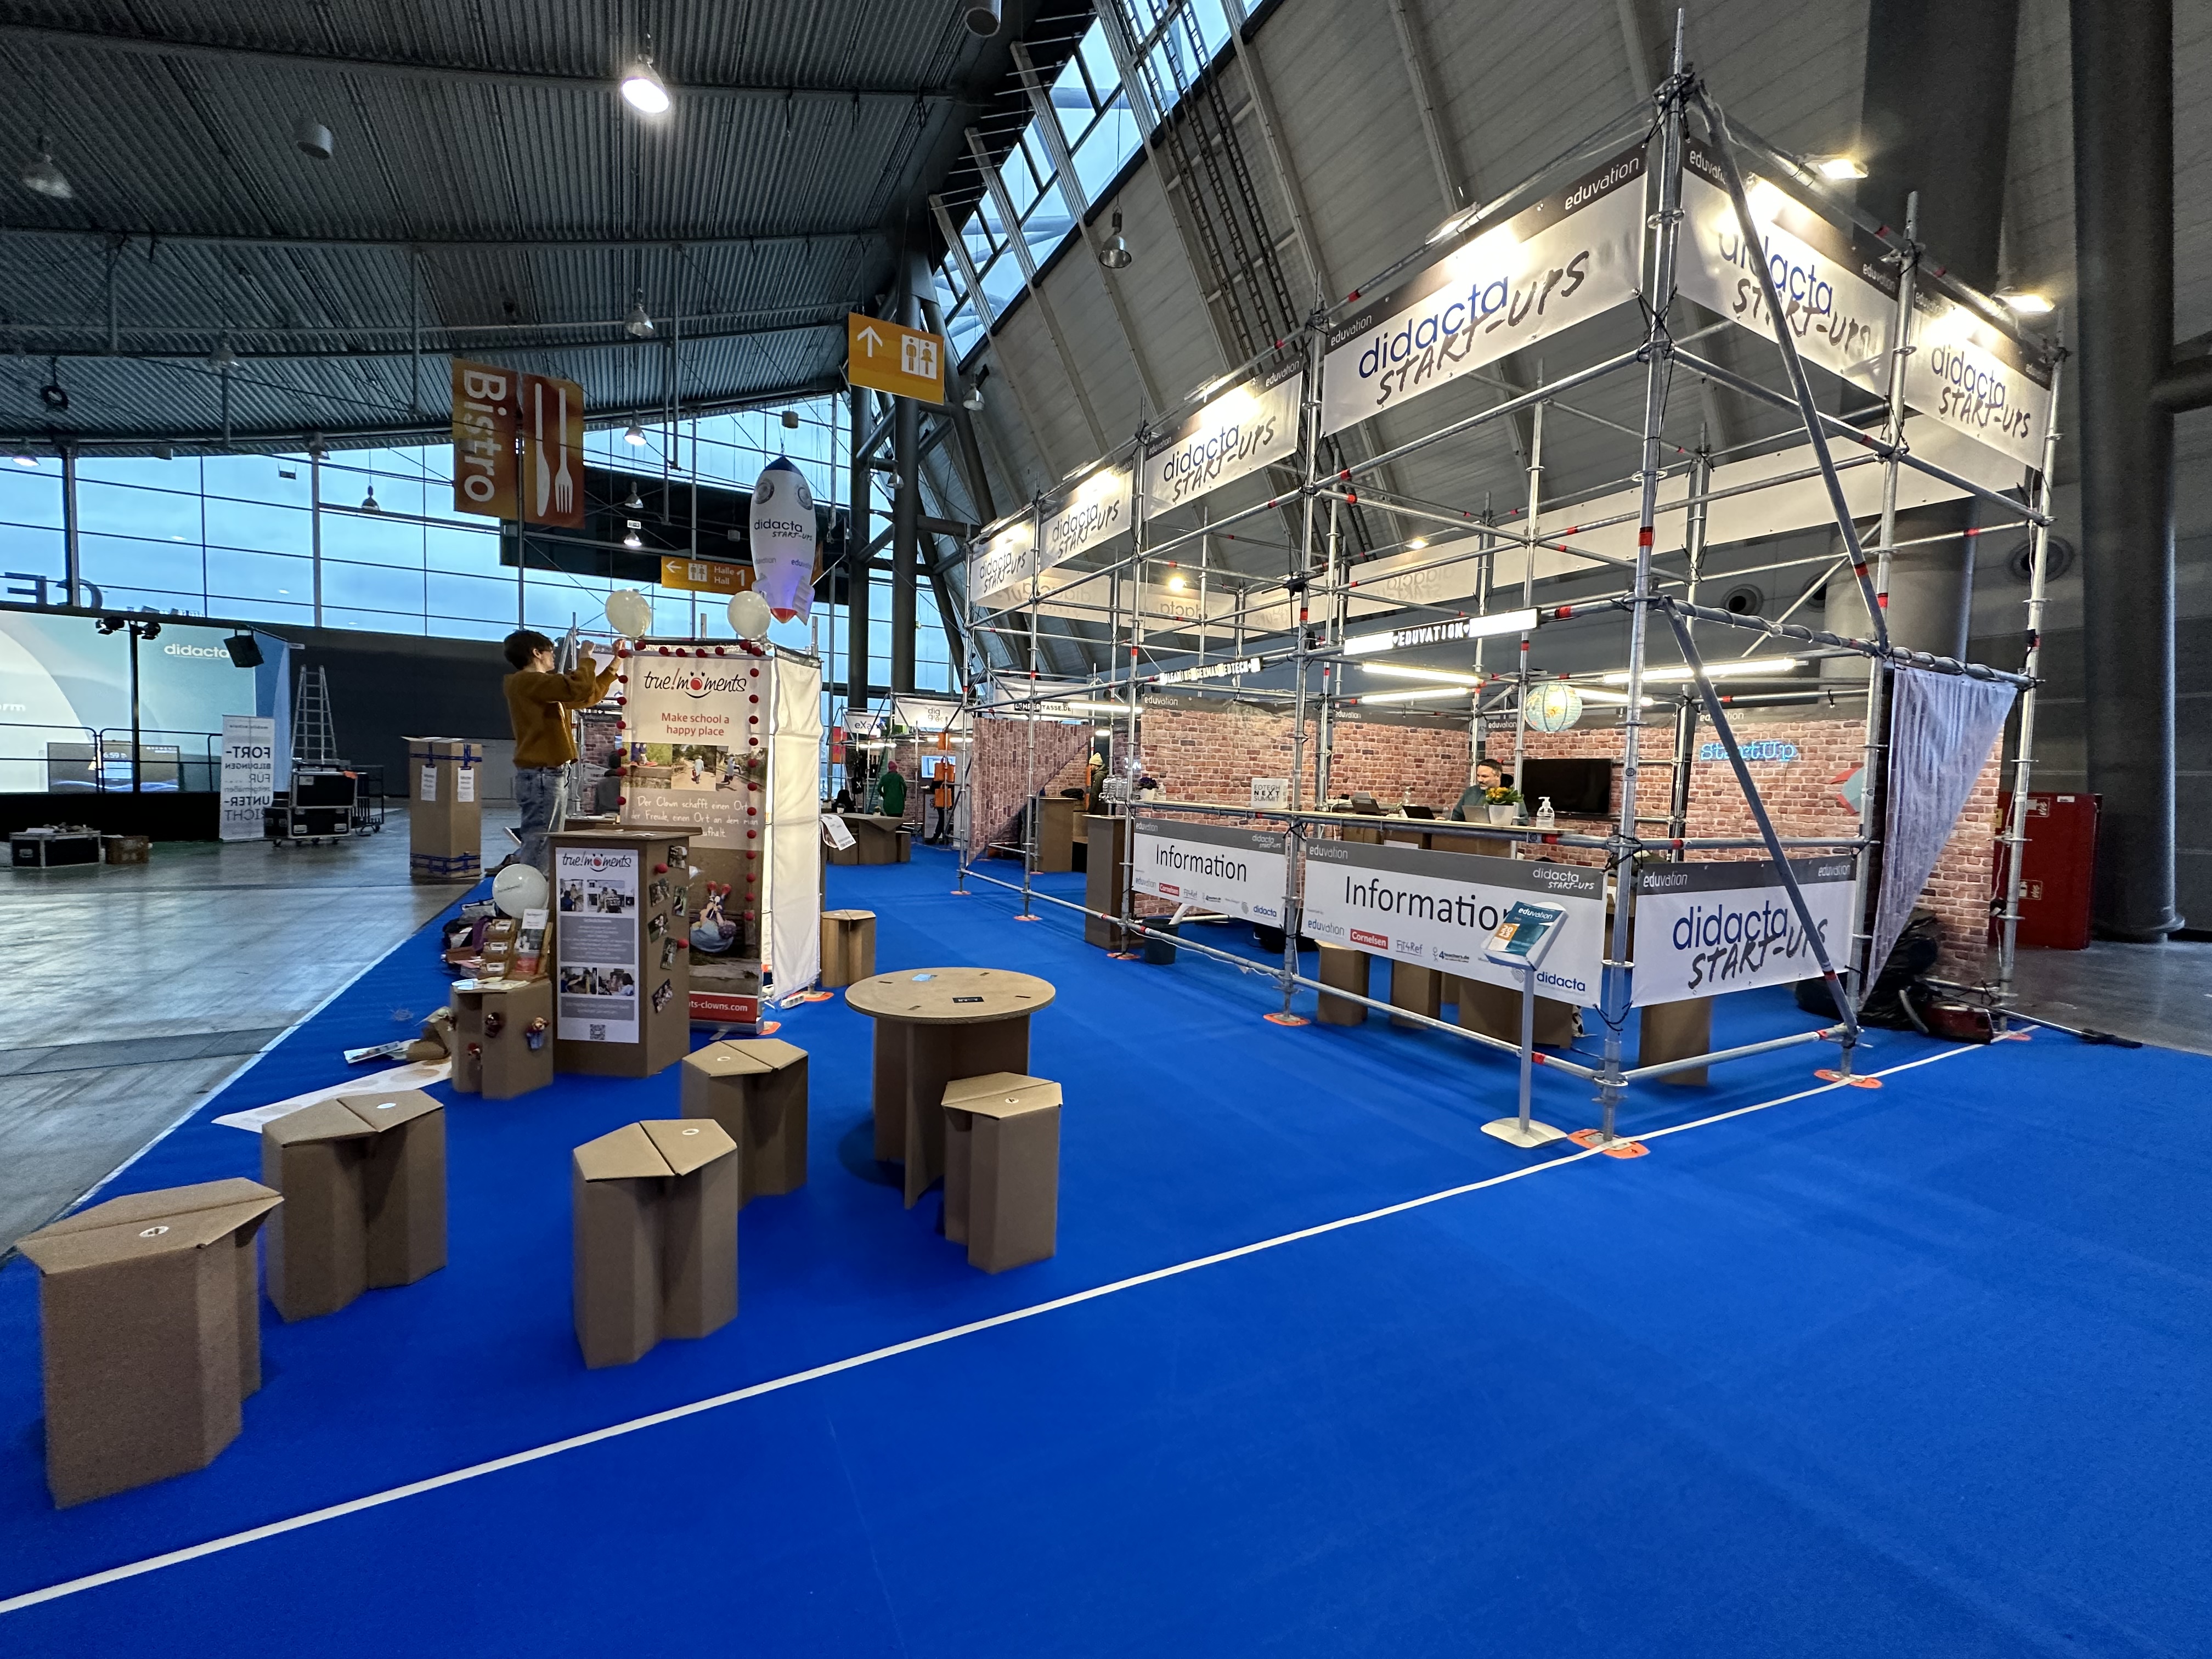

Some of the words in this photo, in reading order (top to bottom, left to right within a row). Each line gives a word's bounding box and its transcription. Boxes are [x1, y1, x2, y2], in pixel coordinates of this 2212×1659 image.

[1690, 150, 1726, 185] eduvati
[1565, 157, 1640, 210] eduvation
[1330, 314, 1373, 346] eduvation
[1358, 276, 1509, 379] didacta
[1376, 250, 1589, 406] START-UPS
[1266, 360, 1300, 387] eduvation
[1932, 344, 2006, 410] didacta
[1939, 386, 2030, 438] START-UPS
[464, 370, 507, 502] Bistro
[1164, 425, 1239, 482] didacta
[1172, 415, 1276, 503] START-UPS
[754, 519, 803, 533] didacta
[1052, 504, 1098, 542] didacta
[1058, 500, 1120, 558] START-UPS
[772, 531, 812, 541] START-UPS
[714, 566, 734, 575] Halle
[980, 551, 1012, 579] didacta
[984, 551, 1026, 594] START-UPS
[737, 569, 745, 586] 1
[1398, 622, 1464, 646] EDUVATION
[164, 644, 230, 658] didacta
[1144, 696, 1178, 707] eduvation
[661, 713, 688, 723] Make
[690, 713, 721, 724] school
[667, 724, 696, 736] happy
[698, 725, 724, 736] place
[1701, 741, 1797, 762] StrtUp
[1254, 787, 1280, 797] NEXT
[637, 795, 652, 807] Der
[656, 797, 678, 808] Clown
[682, 798, 708, 809] schafft
[712, 802, 730, 810] einen
[734, 800, 748, 811] Ort
[673, 814, 690, 822] einen
[694, 812, 710, 823] Ort
[726, 815, 739, 825] dem
[1136, 822, 1158, 832] eduvation
[1309, 844, 1348, 860] eduvation
[1156, 844, 1247, 882] Information
[1818, 863, 1851, 877] eduvation
[1532, 868, 1579, 883] didacta
[1643, 871, 1688, 888] eduvation
[1548, 881, 1595, 890] START-UPS
[1253, 905, 1277, 917] didacta
[1518, 907, 1553, 920] eduvation
[1307, 918, 1345, 936] eduvation
[1503, 924, 1514, 933] 20
[1673, 900, 1788, 950] didacta
[1351, 930, 1387, 947] Cornelsen
[1498, 930, 1511, 938] 23
[1688, 919, 1828, 989] START-US
[1537, 971, 1585, 992] didacta
